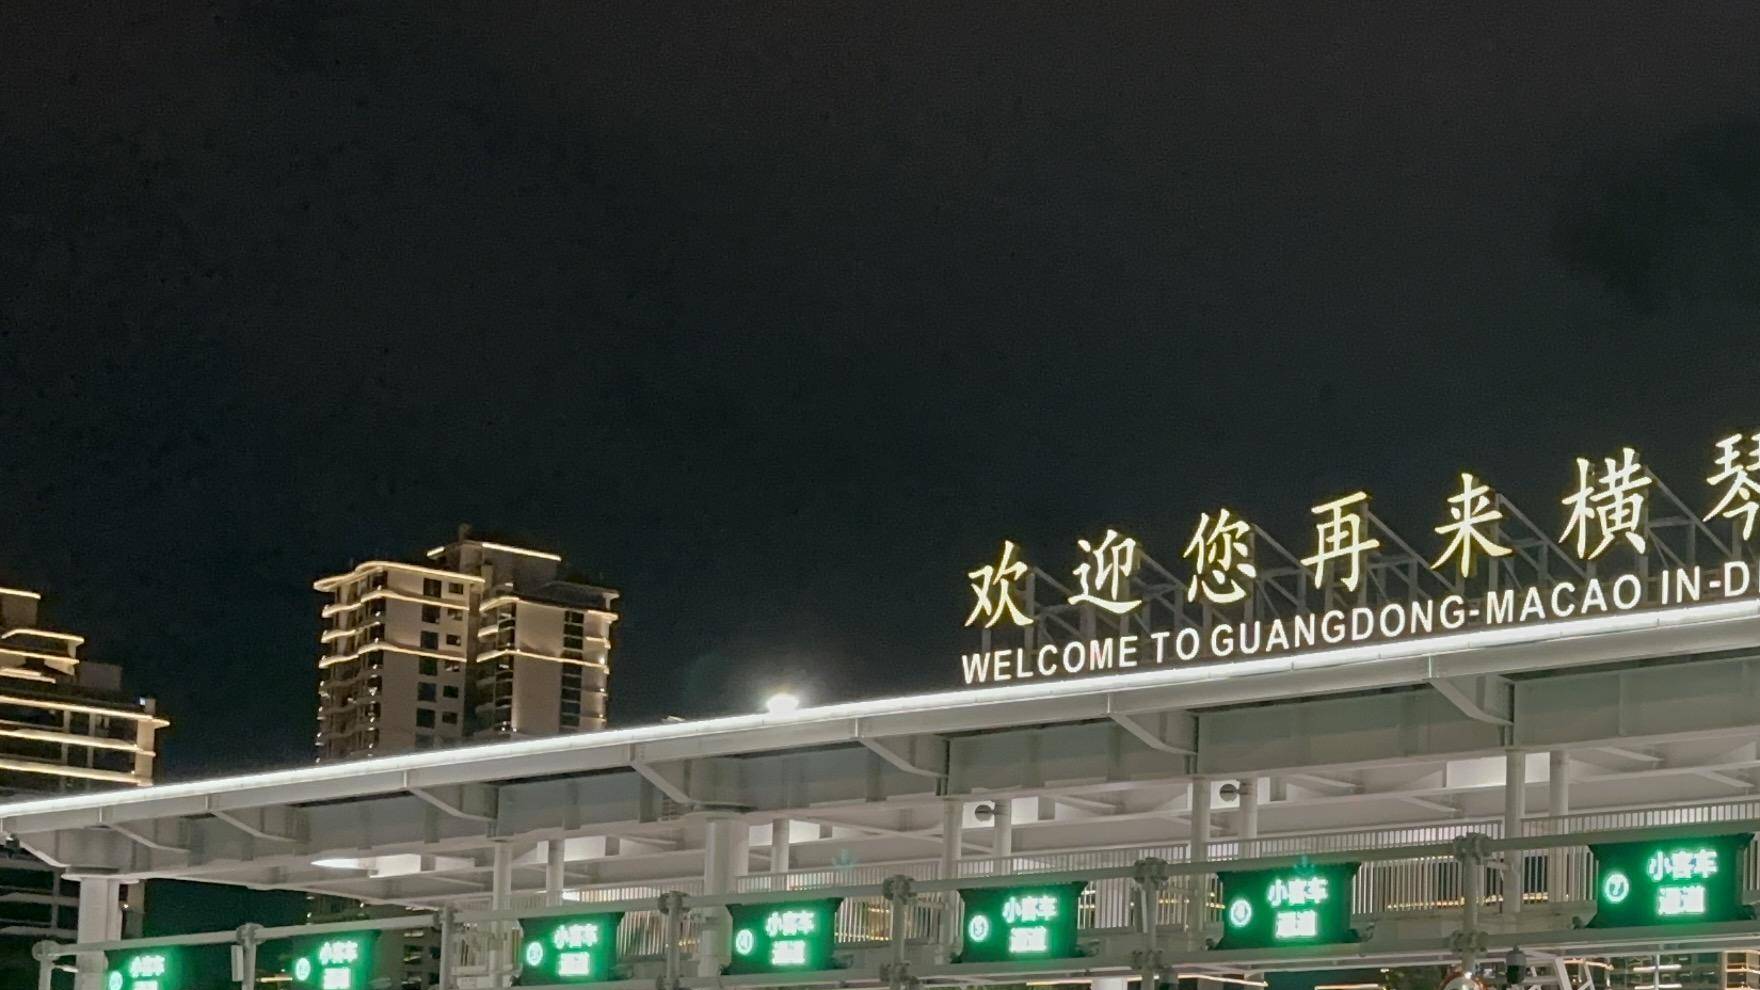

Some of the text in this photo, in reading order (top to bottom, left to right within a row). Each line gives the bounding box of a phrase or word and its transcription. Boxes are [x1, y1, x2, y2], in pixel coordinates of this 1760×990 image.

[961, 632, 1135, 685] WELCOME
[1152, 627, 1199, 663] TO
[1211, 572, 1642, 657] GUANGDONG-MACAO
